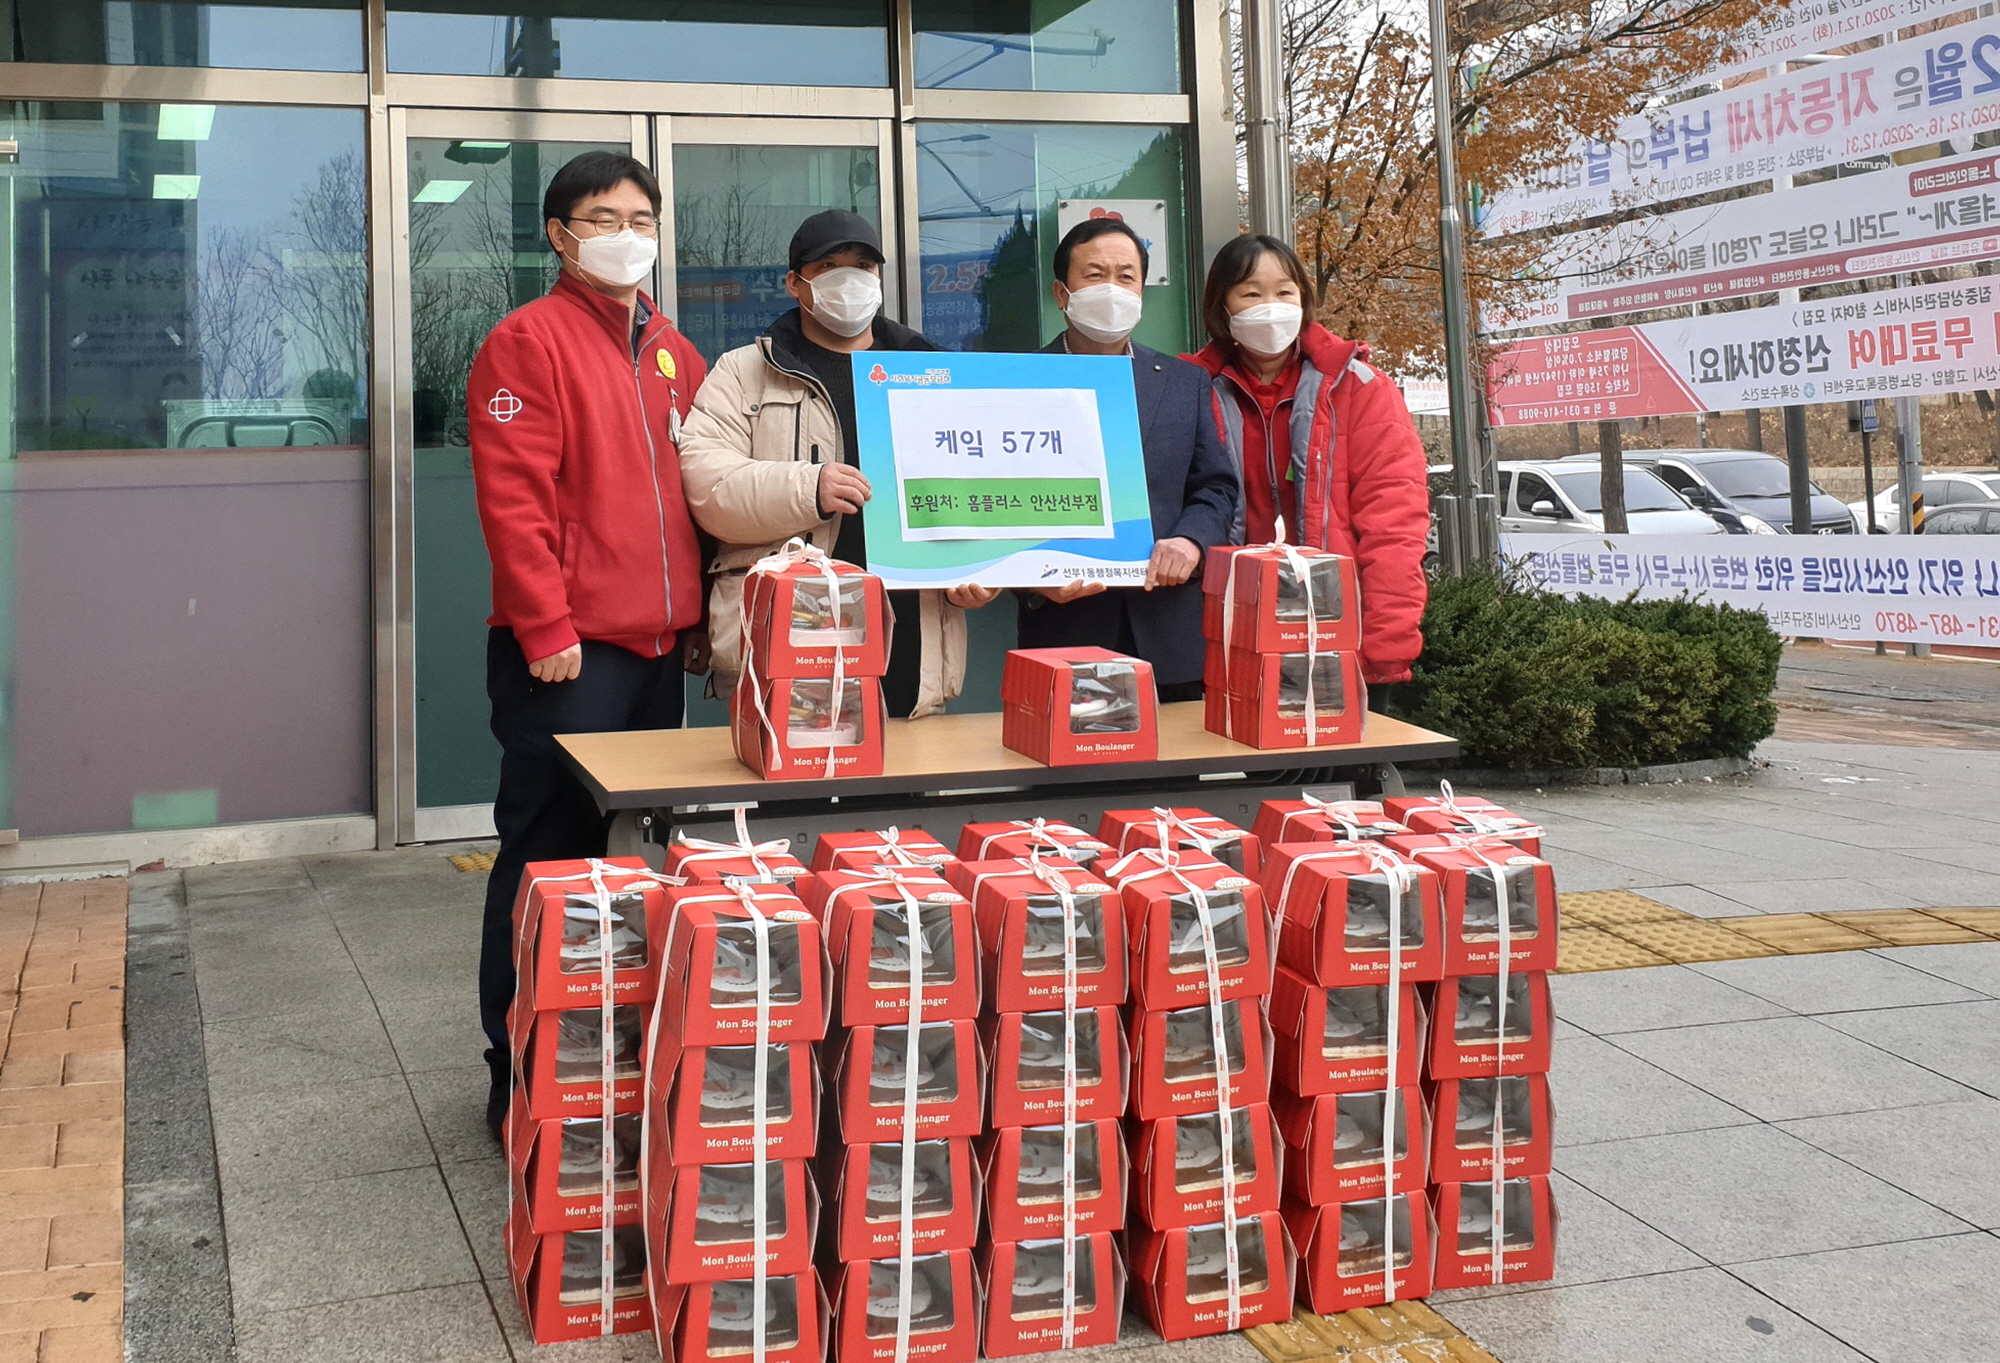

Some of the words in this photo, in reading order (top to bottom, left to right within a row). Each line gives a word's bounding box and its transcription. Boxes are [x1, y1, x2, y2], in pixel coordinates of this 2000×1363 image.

[934, 429, 984, 458] 케잌
[1001, 430, 1063, 455] 57개
[910, 494, 958, 513] 후원처:
[967, 495, 1023, 512] 홈플러스
[1030, 494, 1098, 513] 안산선부점
[1062, 567, 1149, 579] 선부1동행정복지센터
[1281, 632, 1297, 640] Mon
[1096, 743, 1134, 751] Boulanger
[1468, 953, 1486, 961] Mon
[1350, 963, 1369, 971] Mon
[567, 985, 588, 993] Mon
[591, 982, 640, 991] Boanger
[1176, 984, 1196, 992] Mon
[1199, 977, 1243, 989] Boanger
[1029, 987, 1048, 995] Mon
[900, 997, 948, 1006] Boanger
[717, 1020, 738, 1028] Mon
[1460, 1055, 1478, 1063] Mon
[1329, 1071, 1347, 1079] Mon
[563, 1094, 583, 1102] Mon
[1172, 1093, 1191, 1101] Mon
[1024, 1102, 1044, 1110] Mon
[876, 1117, 897, 1126] Mon
[707, 1139, 728, 1147] Mon
[1461, 1159, 1480, 1167] Mon
[1339, 1179, 1357, 1187] Mon
[1184, 1203, 1203, 1212] Mon
[566, 1208, 586, 1216] Mon
[1047, 1212, 1094, 1222] Bounger
[873, 1234, 894, 1243] Mon
[702, 1257, 724, 1266] Mon
[1343, 1287, 1361, 1295] Mon
[567, 1316, 588, 1325] Mon
[592, 1310, 640, 1322] Boanger
[1195, 1313, 1214, 1321] Mon
[1018, 1332, 1038, 1340] Mon
[1042, 1326, 1088, 1337] Boulger
[873, 1349, 894, 1358] Mon
